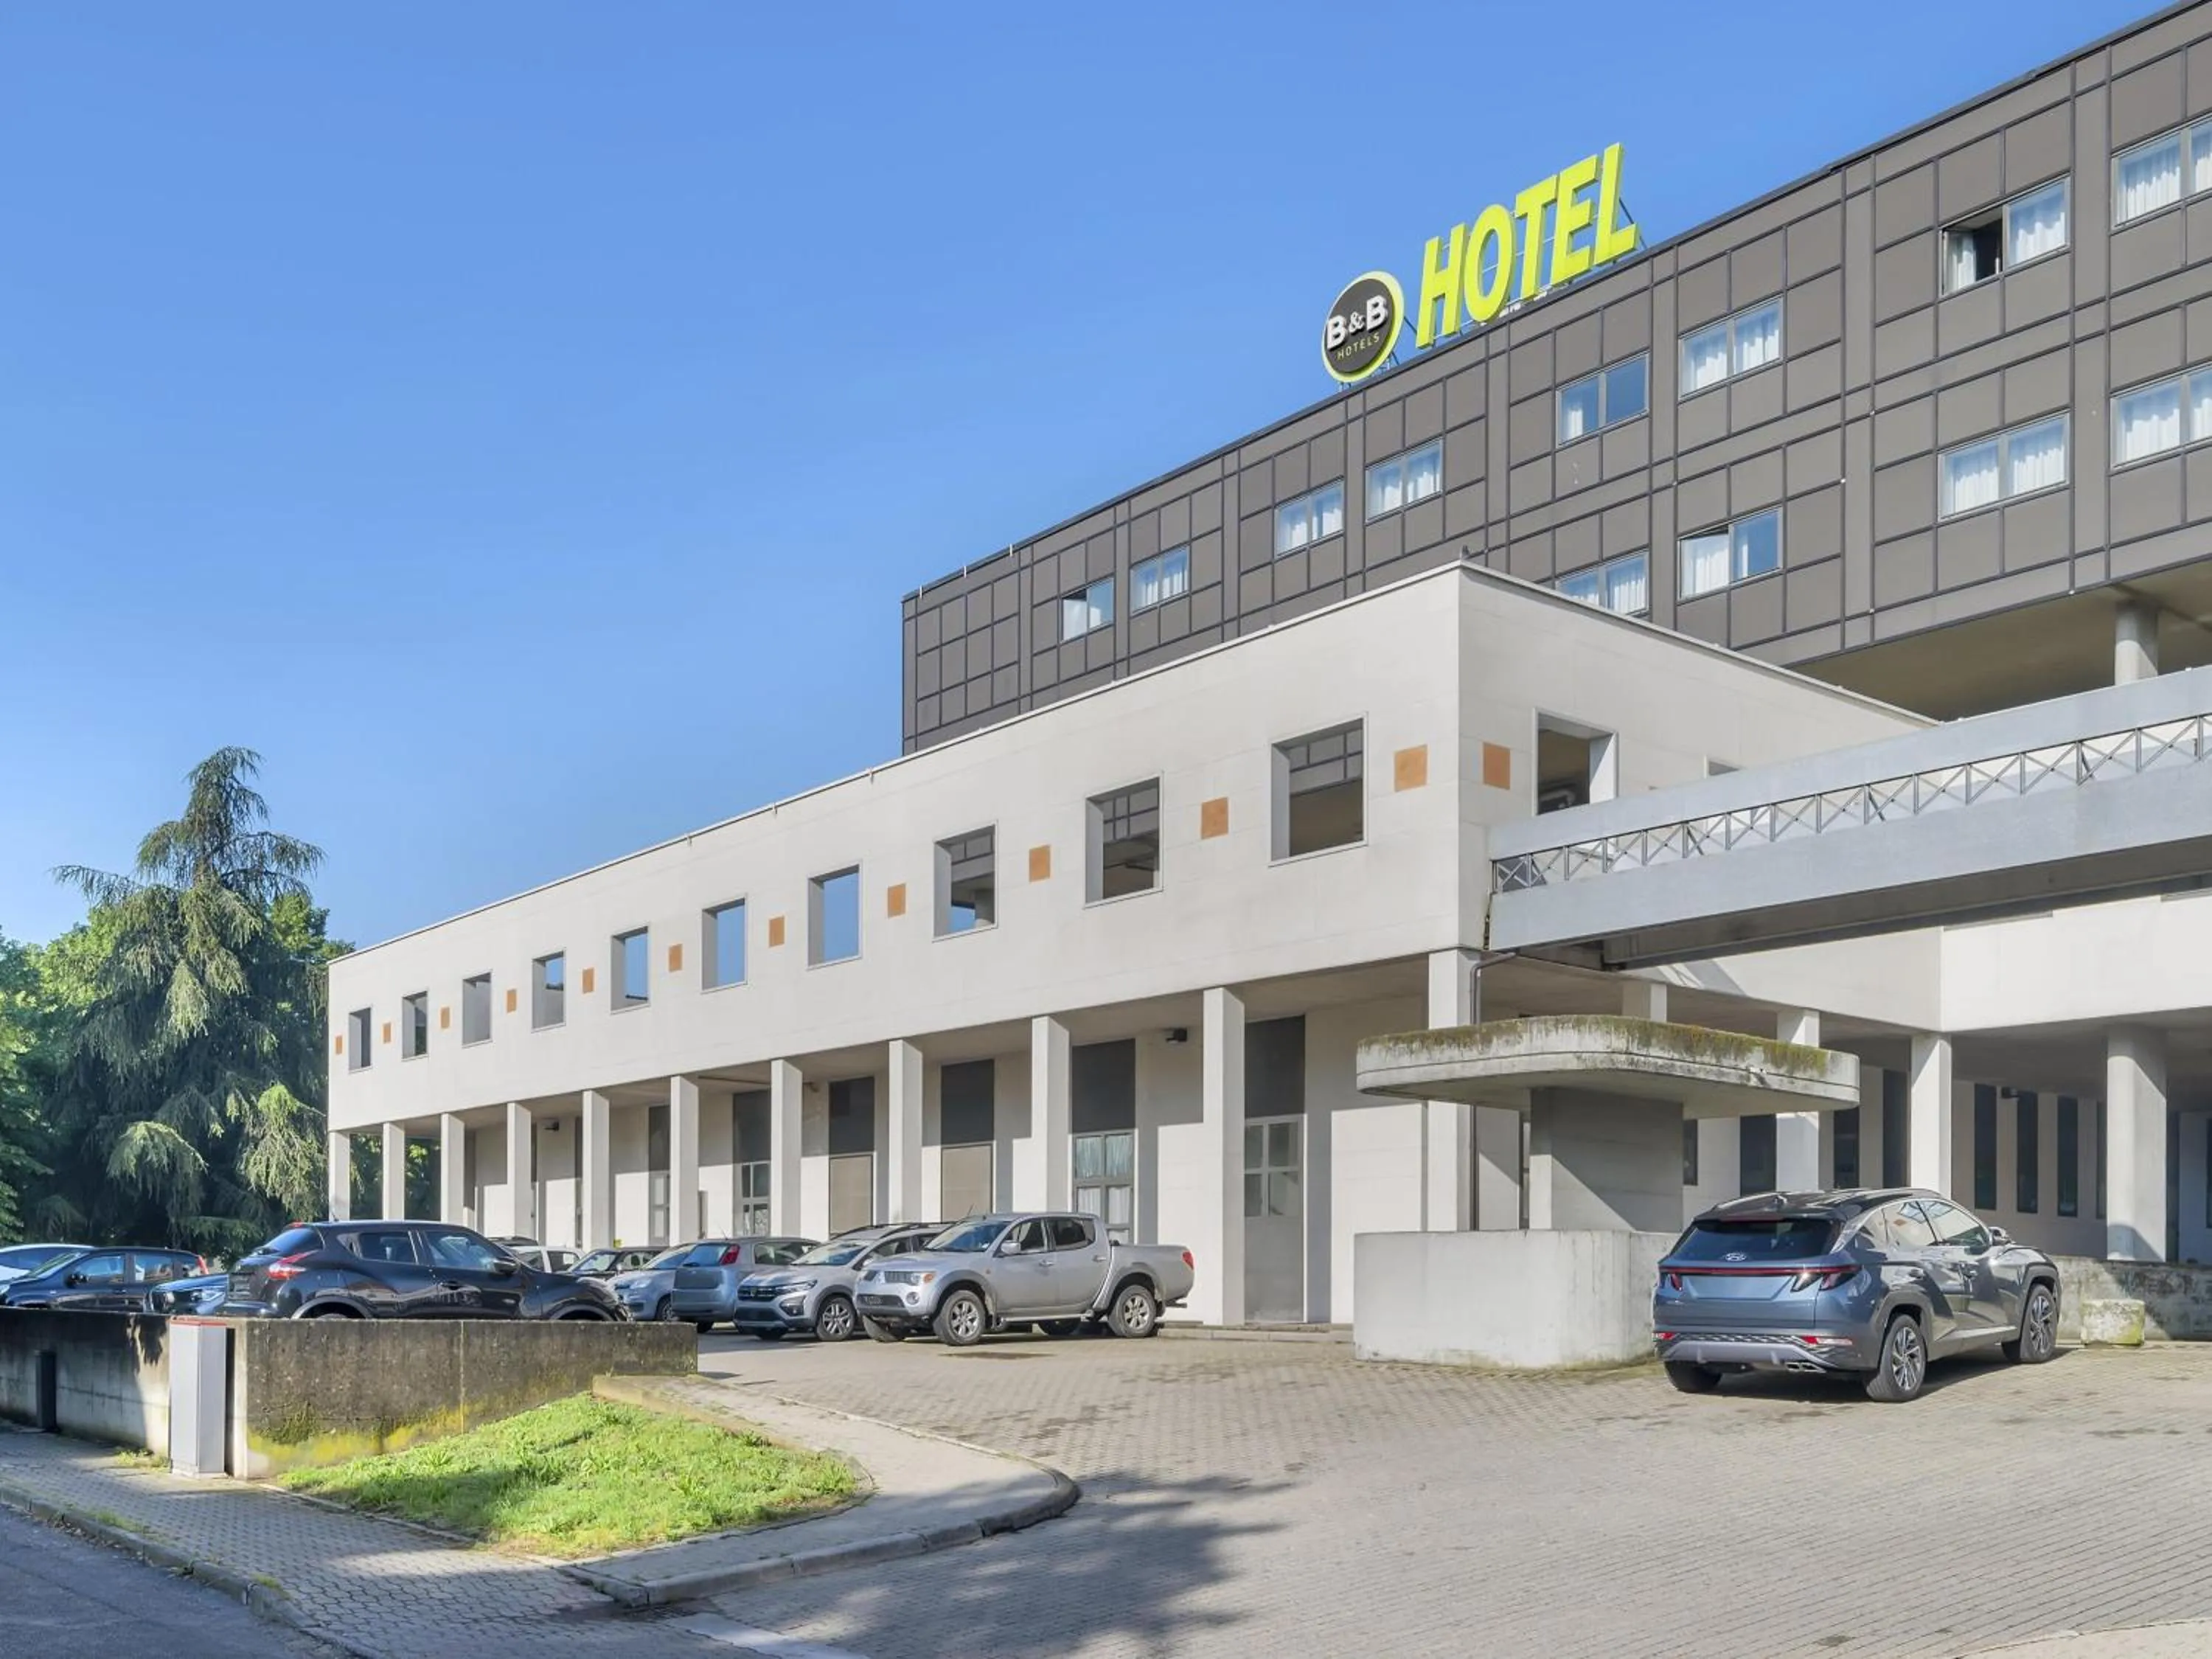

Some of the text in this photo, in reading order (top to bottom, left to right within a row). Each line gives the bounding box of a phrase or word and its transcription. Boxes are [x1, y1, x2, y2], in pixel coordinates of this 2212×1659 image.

[1416, 142, 1636, 349] HOTEL
[1326, 295, 1388, 350] B&B
[1337, 333, 1380, 360] HOTELS
